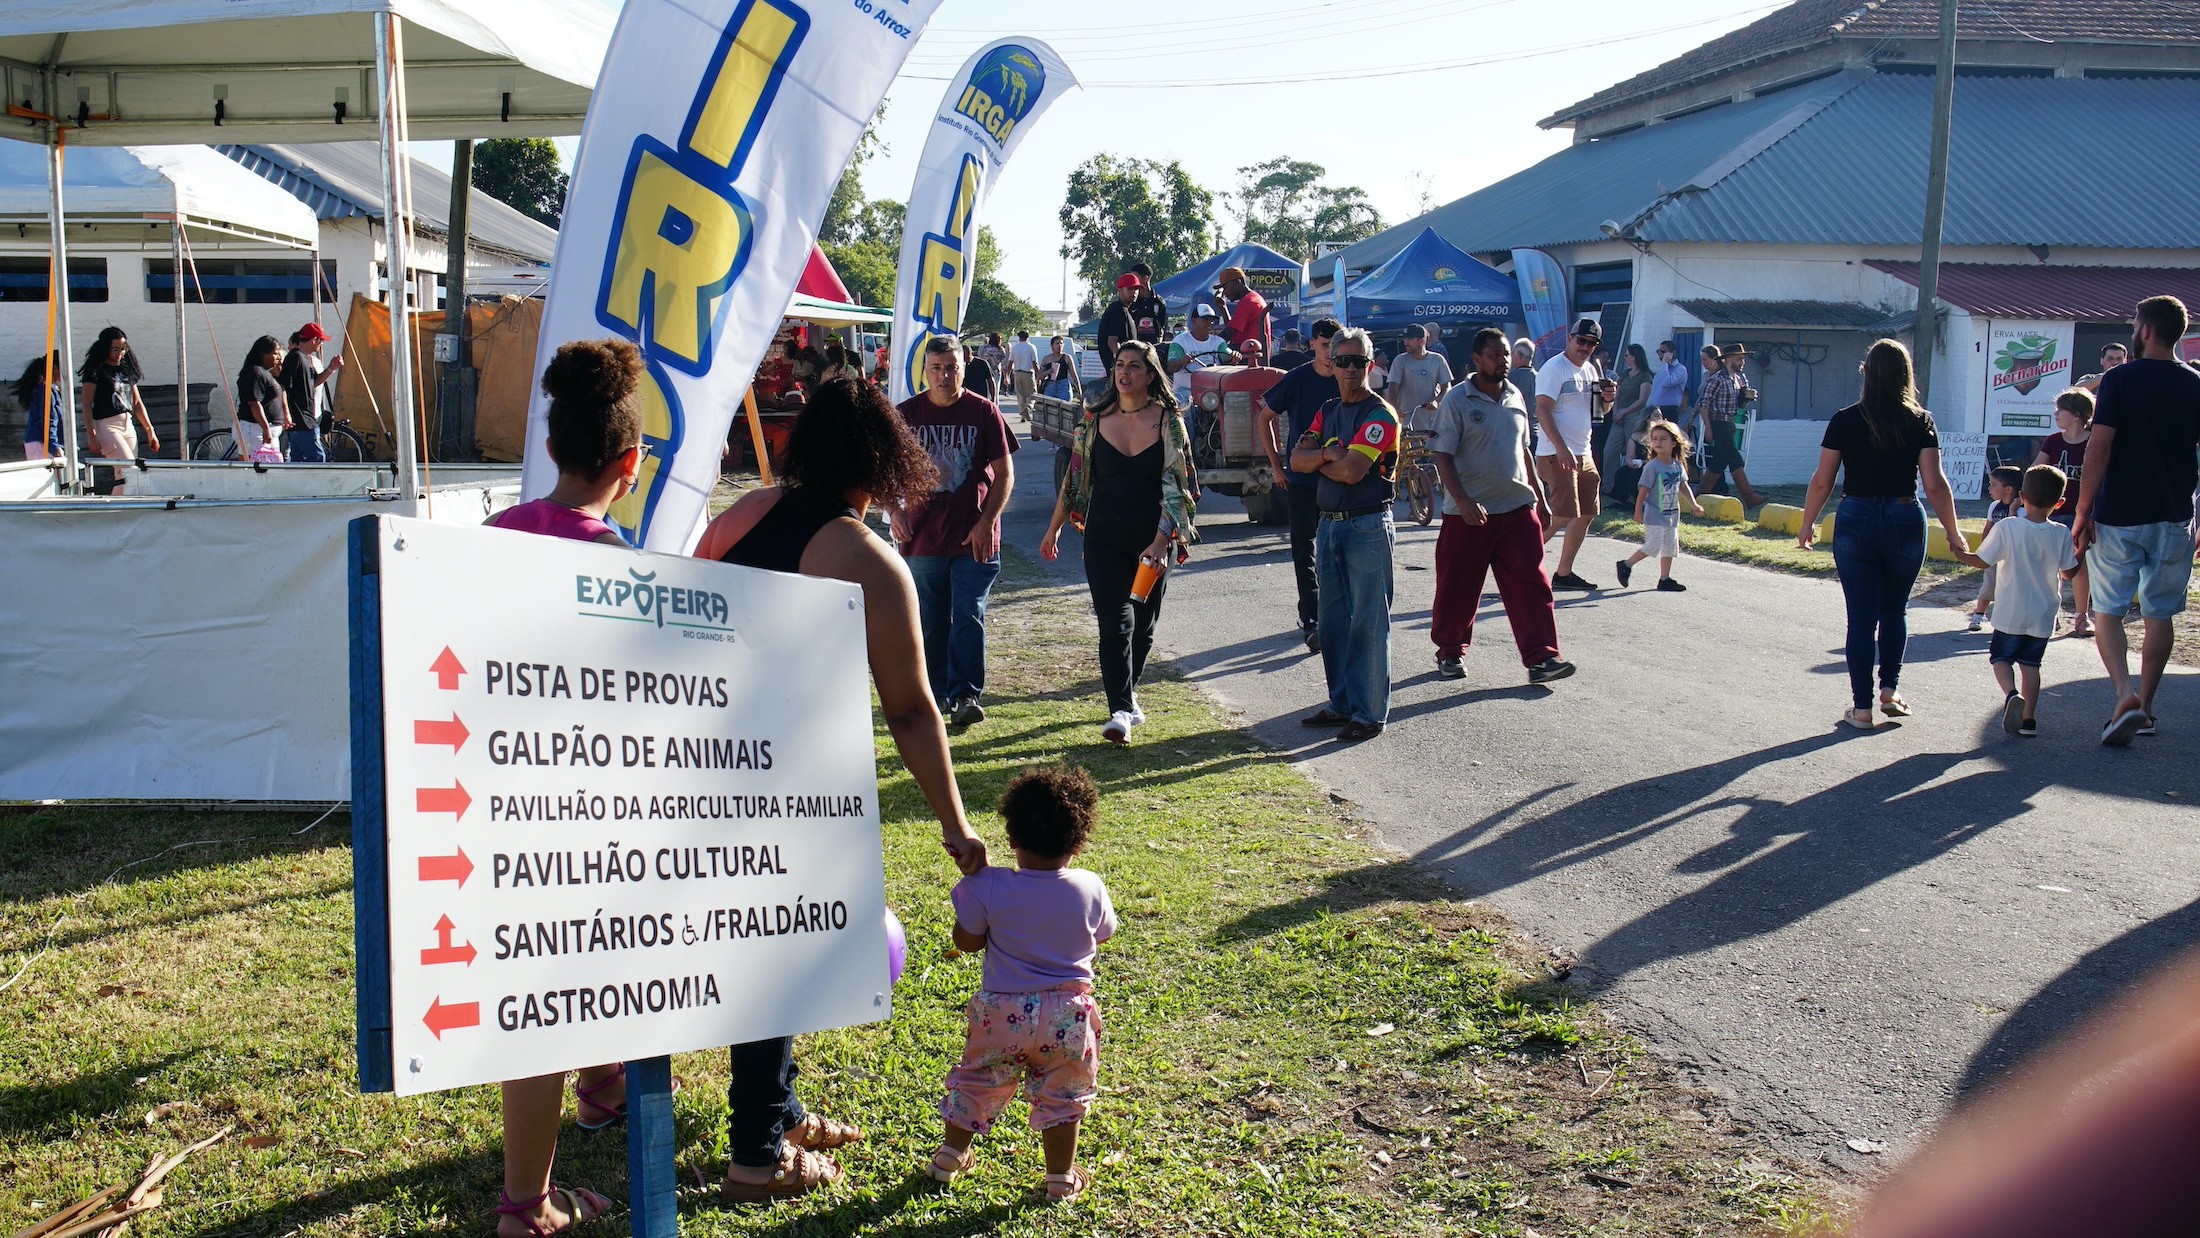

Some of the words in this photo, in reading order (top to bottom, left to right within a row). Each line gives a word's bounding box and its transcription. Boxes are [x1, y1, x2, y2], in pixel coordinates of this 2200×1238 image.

[873, 9, 911, 40] Arroz
[937, 114, 963, 131] Instituto
[963, 124, 974, 137] Rio
[955, 84, 1016, 150] IRGA
[1250, 275, 1288, 285] PIPOCA
[1424, 286, 1443, 294] DB
[1425, 304, 1446, 316] (53)
[1448, 304, 1509, 316] 99929-6200
[1975, 341, 1980, 353] 1
[1994, 330, 2014, 338] ERVA
[2016, 330, 2038, 339] MATE
[1993, 358, 2068, 387] Bernardon
[909, 424, 978, 449] ONFIAR
[1951, 446, 1985, 456] QUENTE
[1952, 460, 1980, 476] MATE
[576, 566, 729, 629] EXPOFEIRA
[683, 630, 695, 639] RIO
[486, 660, 572, 699] PISTA
[580, 667, 616, 702] DE
[625, 670, 729, 708] PROVAS
[488, 724, 611, 767] GALPÃO
[621, 735, 656, 768] DE
[664, 737, 773, 771] ANIMAIS
[490, 789, 606, 821] PAVILHÃO
[613, 796, 643, 820] DA
[648, 795, 782, 820] AGRICULTURA
[785, 795, 864, 818] FAMILIAR
[493, 841, 646, 889] PAVILHÃO
[655, 844, 788, 881] CULTURAL
[494, 908, 674, 960] SANITÁRIOS
[703, 894, 848, 942] /FRALDÁRIO
[497, 973, 721, 1032] GASTRONOMIA
